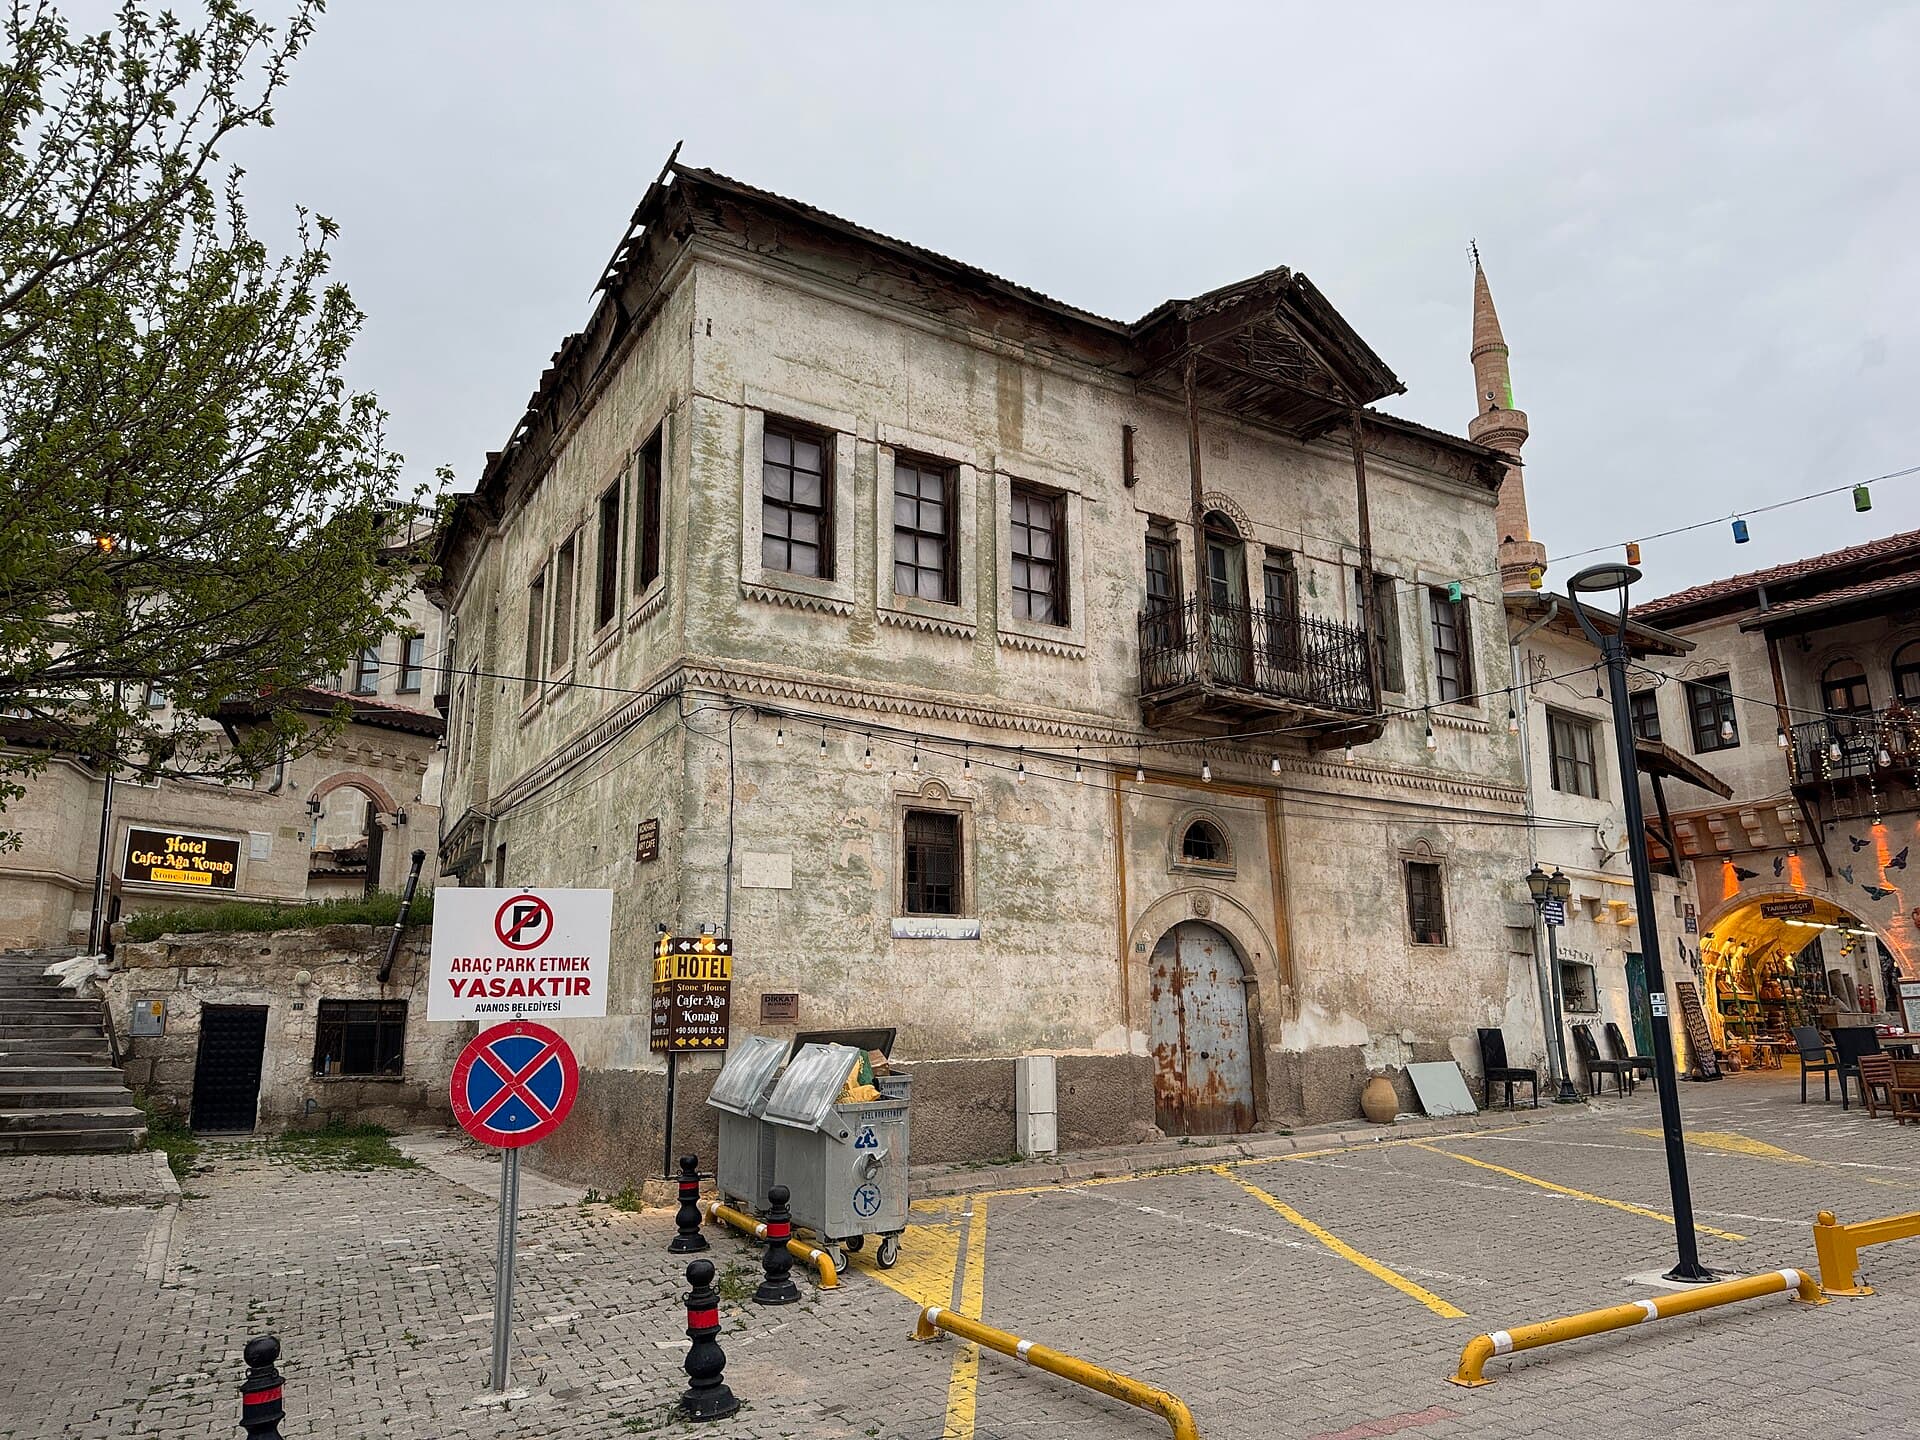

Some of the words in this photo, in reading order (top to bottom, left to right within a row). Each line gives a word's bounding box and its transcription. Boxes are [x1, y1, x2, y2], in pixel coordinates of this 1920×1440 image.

[164, 836, 207, 855] Hotel
[131, 851, 164, 866] Cafer
[164, 853, 190, 869] Ağa
[191, 856, 233, 874] Konağı
[153, 871, 178, 881] Stone
[450, 958, 492, 975] ARAÇ
[496, 957, 536, 972] PARK
[540, 957, 590, 972] ETMEK
[677, 956, 728, 978] HOTEL
[448, 977, 591, 998] YASAKTIR
[677, 983, 699, 992] Stone
[475, 1002, 510, 1013] AVANOS
[511, 1000, 561, 1012] BELEDİYESİ
[677, 994, 704, 1008] Cafer
[704, 995, 726, 1008] Ağa
[682, 1010, 719, 1024] Konağı
